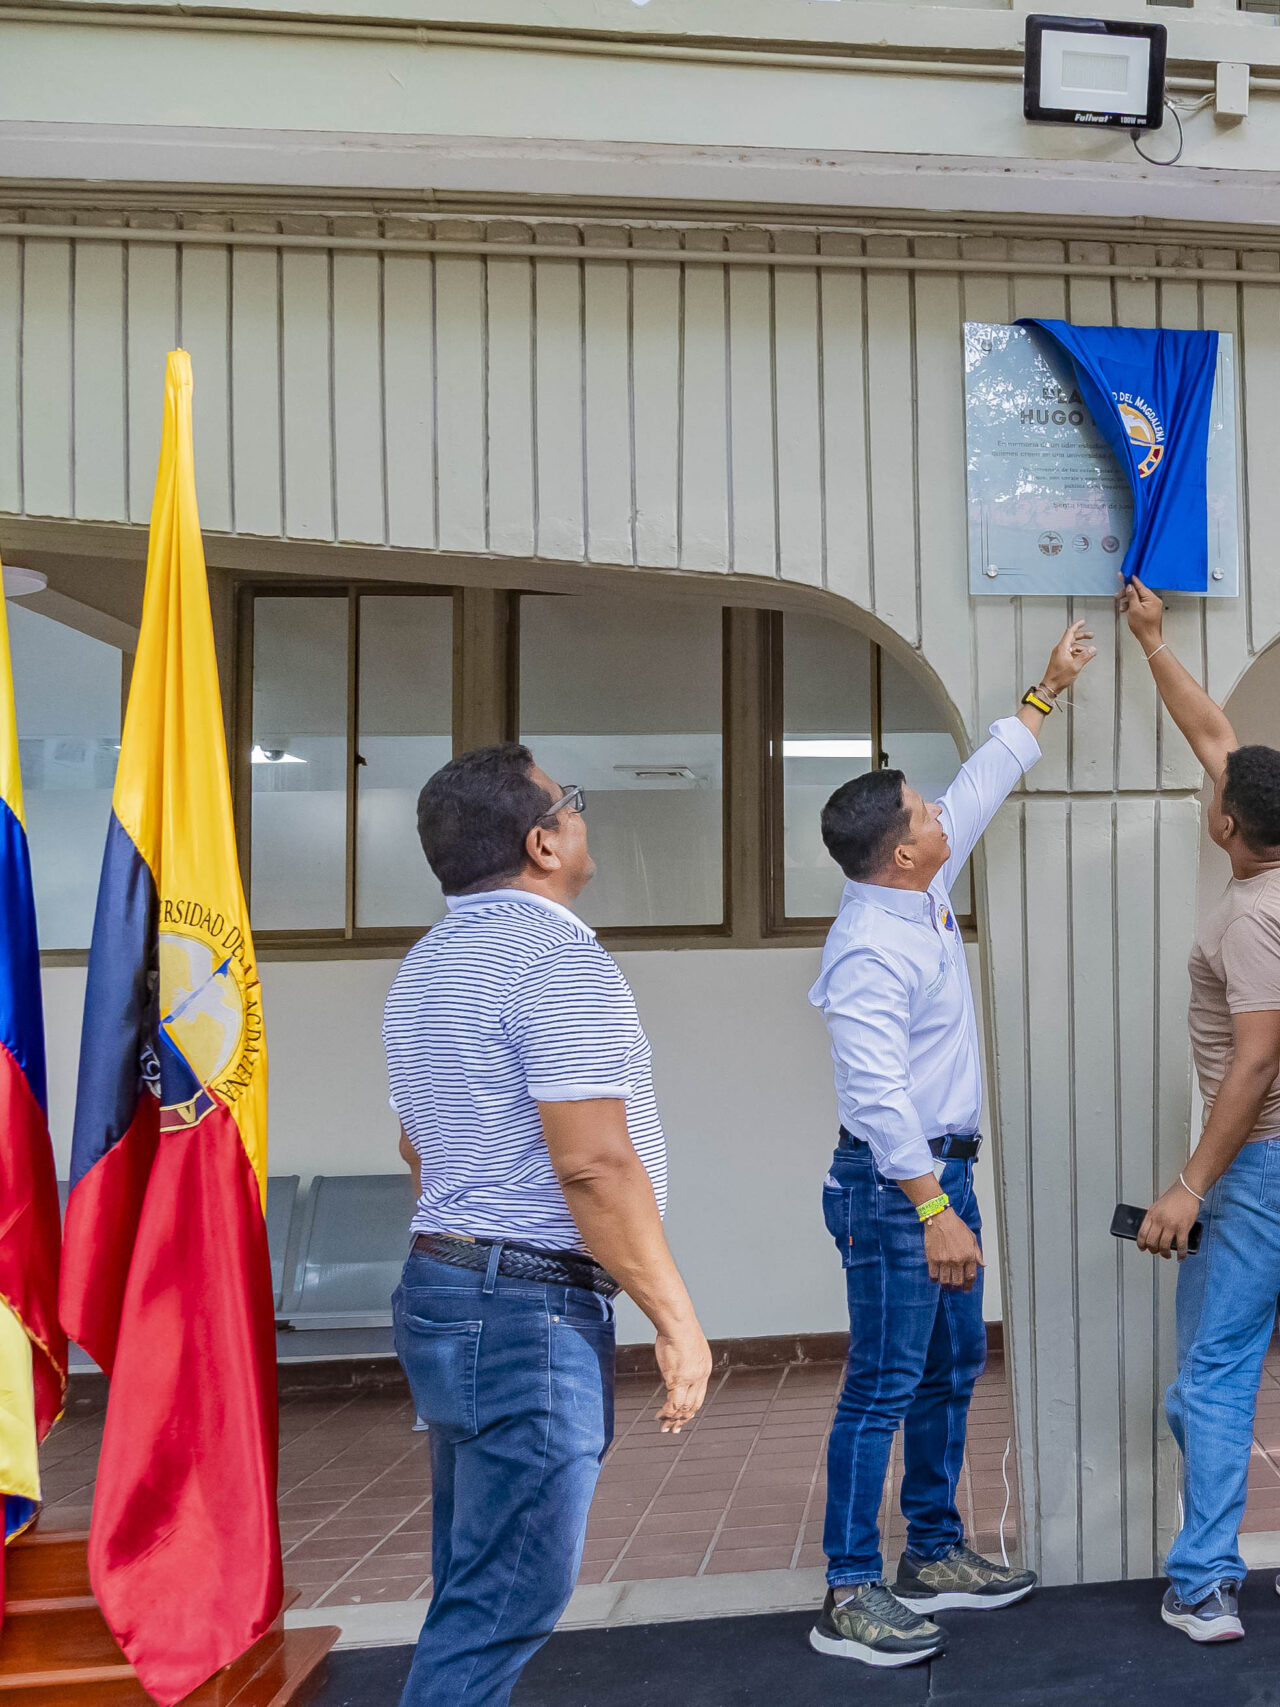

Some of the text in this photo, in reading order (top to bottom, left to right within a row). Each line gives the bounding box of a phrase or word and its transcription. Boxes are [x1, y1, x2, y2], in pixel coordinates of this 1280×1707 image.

[1119, 391, 1133, 404] DEL
[1020, 409, 1084, 426] HUGO
[158, 899, 224, 937] RSIDAD
